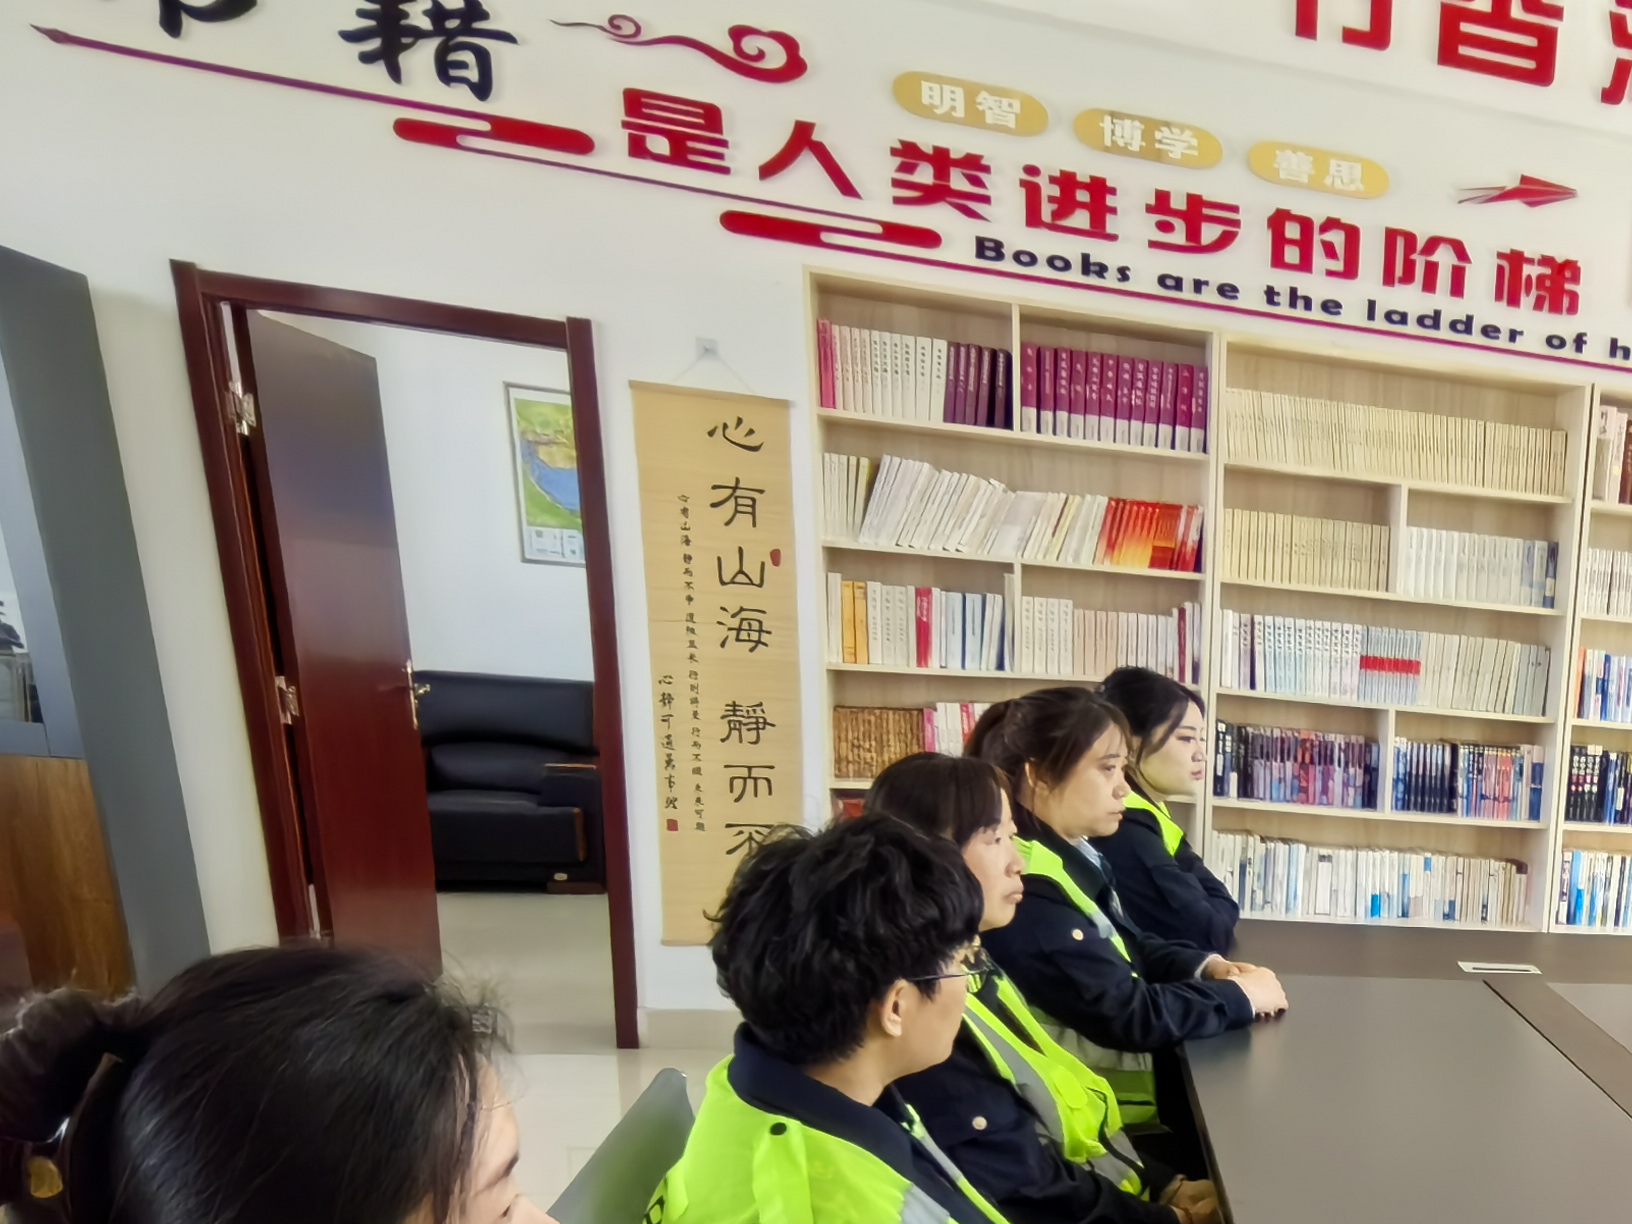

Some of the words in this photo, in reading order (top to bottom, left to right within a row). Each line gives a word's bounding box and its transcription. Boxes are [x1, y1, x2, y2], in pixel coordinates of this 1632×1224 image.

[158, 0, 518, 101] 籍
[921, 80, 1021, 129] 明智
[1099, 115, 1198, 160] 博学
[621, 87, 1582, 316] 是人类进步的阶梯
[1274, 149, 1365, 191] 善思
[974, 236, 1131, 283] Books
[1156, 272, 1240, 301] are
[1264, 284, 1344, 316] the
[1366, 298, 1524, 344] ladder
[1545, 332, 1588, 354] of
[707, 415, 773, 653] 心有山海
